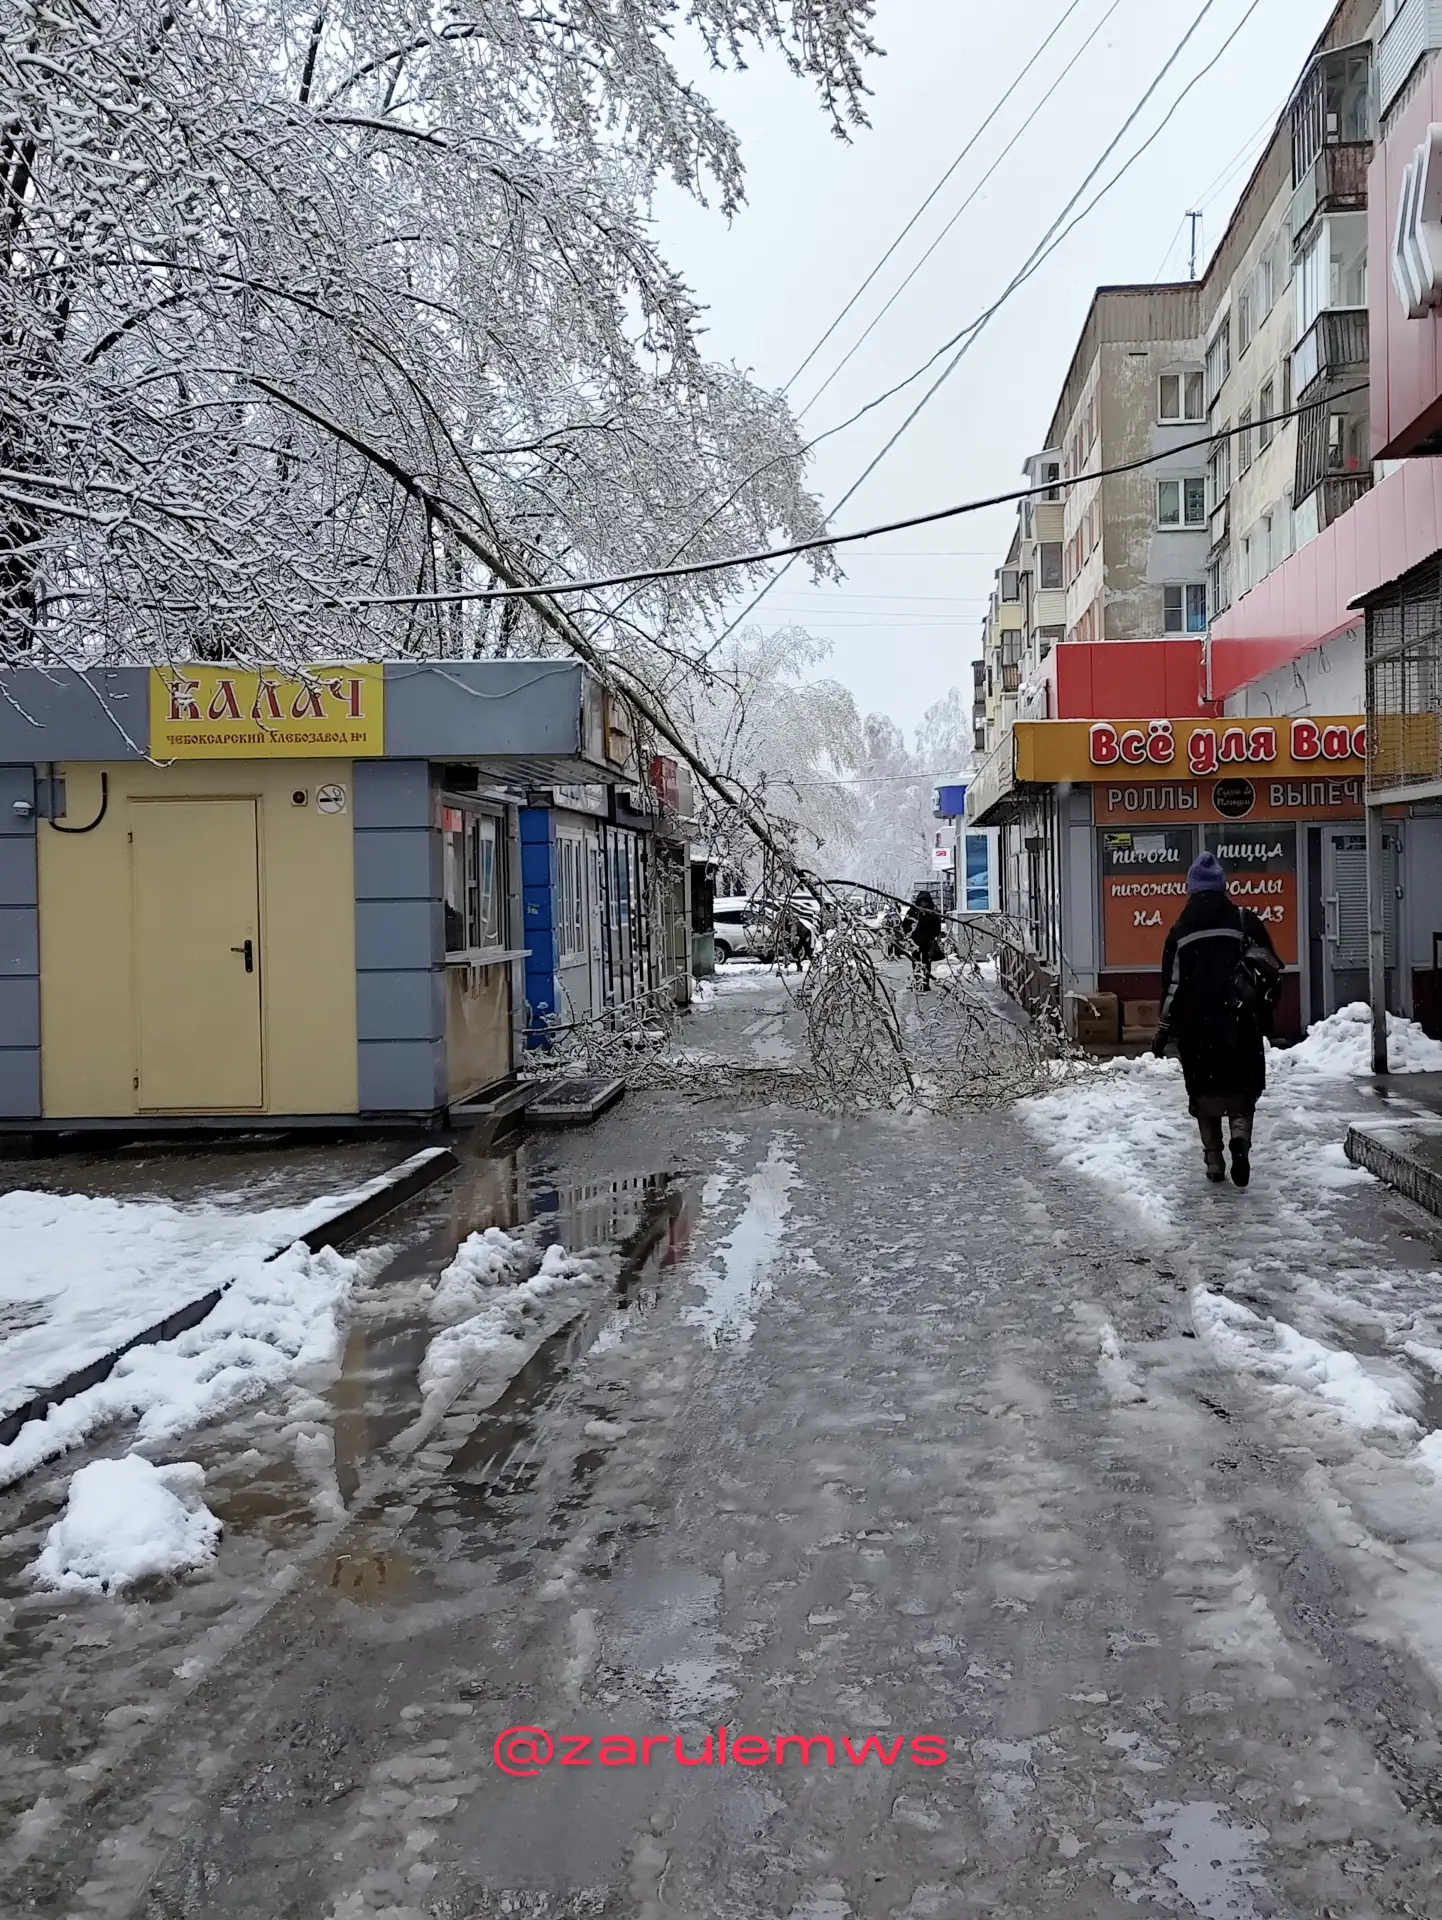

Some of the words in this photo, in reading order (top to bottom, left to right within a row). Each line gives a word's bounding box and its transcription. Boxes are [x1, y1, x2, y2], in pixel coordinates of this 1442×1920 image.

[165, 678, 366, 721] КАЛАЧ
[1089, 719, 1175, 764] Всё
[1188, 727, 1277, 776] для
[1108, 786, 1199, 811] РОЛЛЫ
